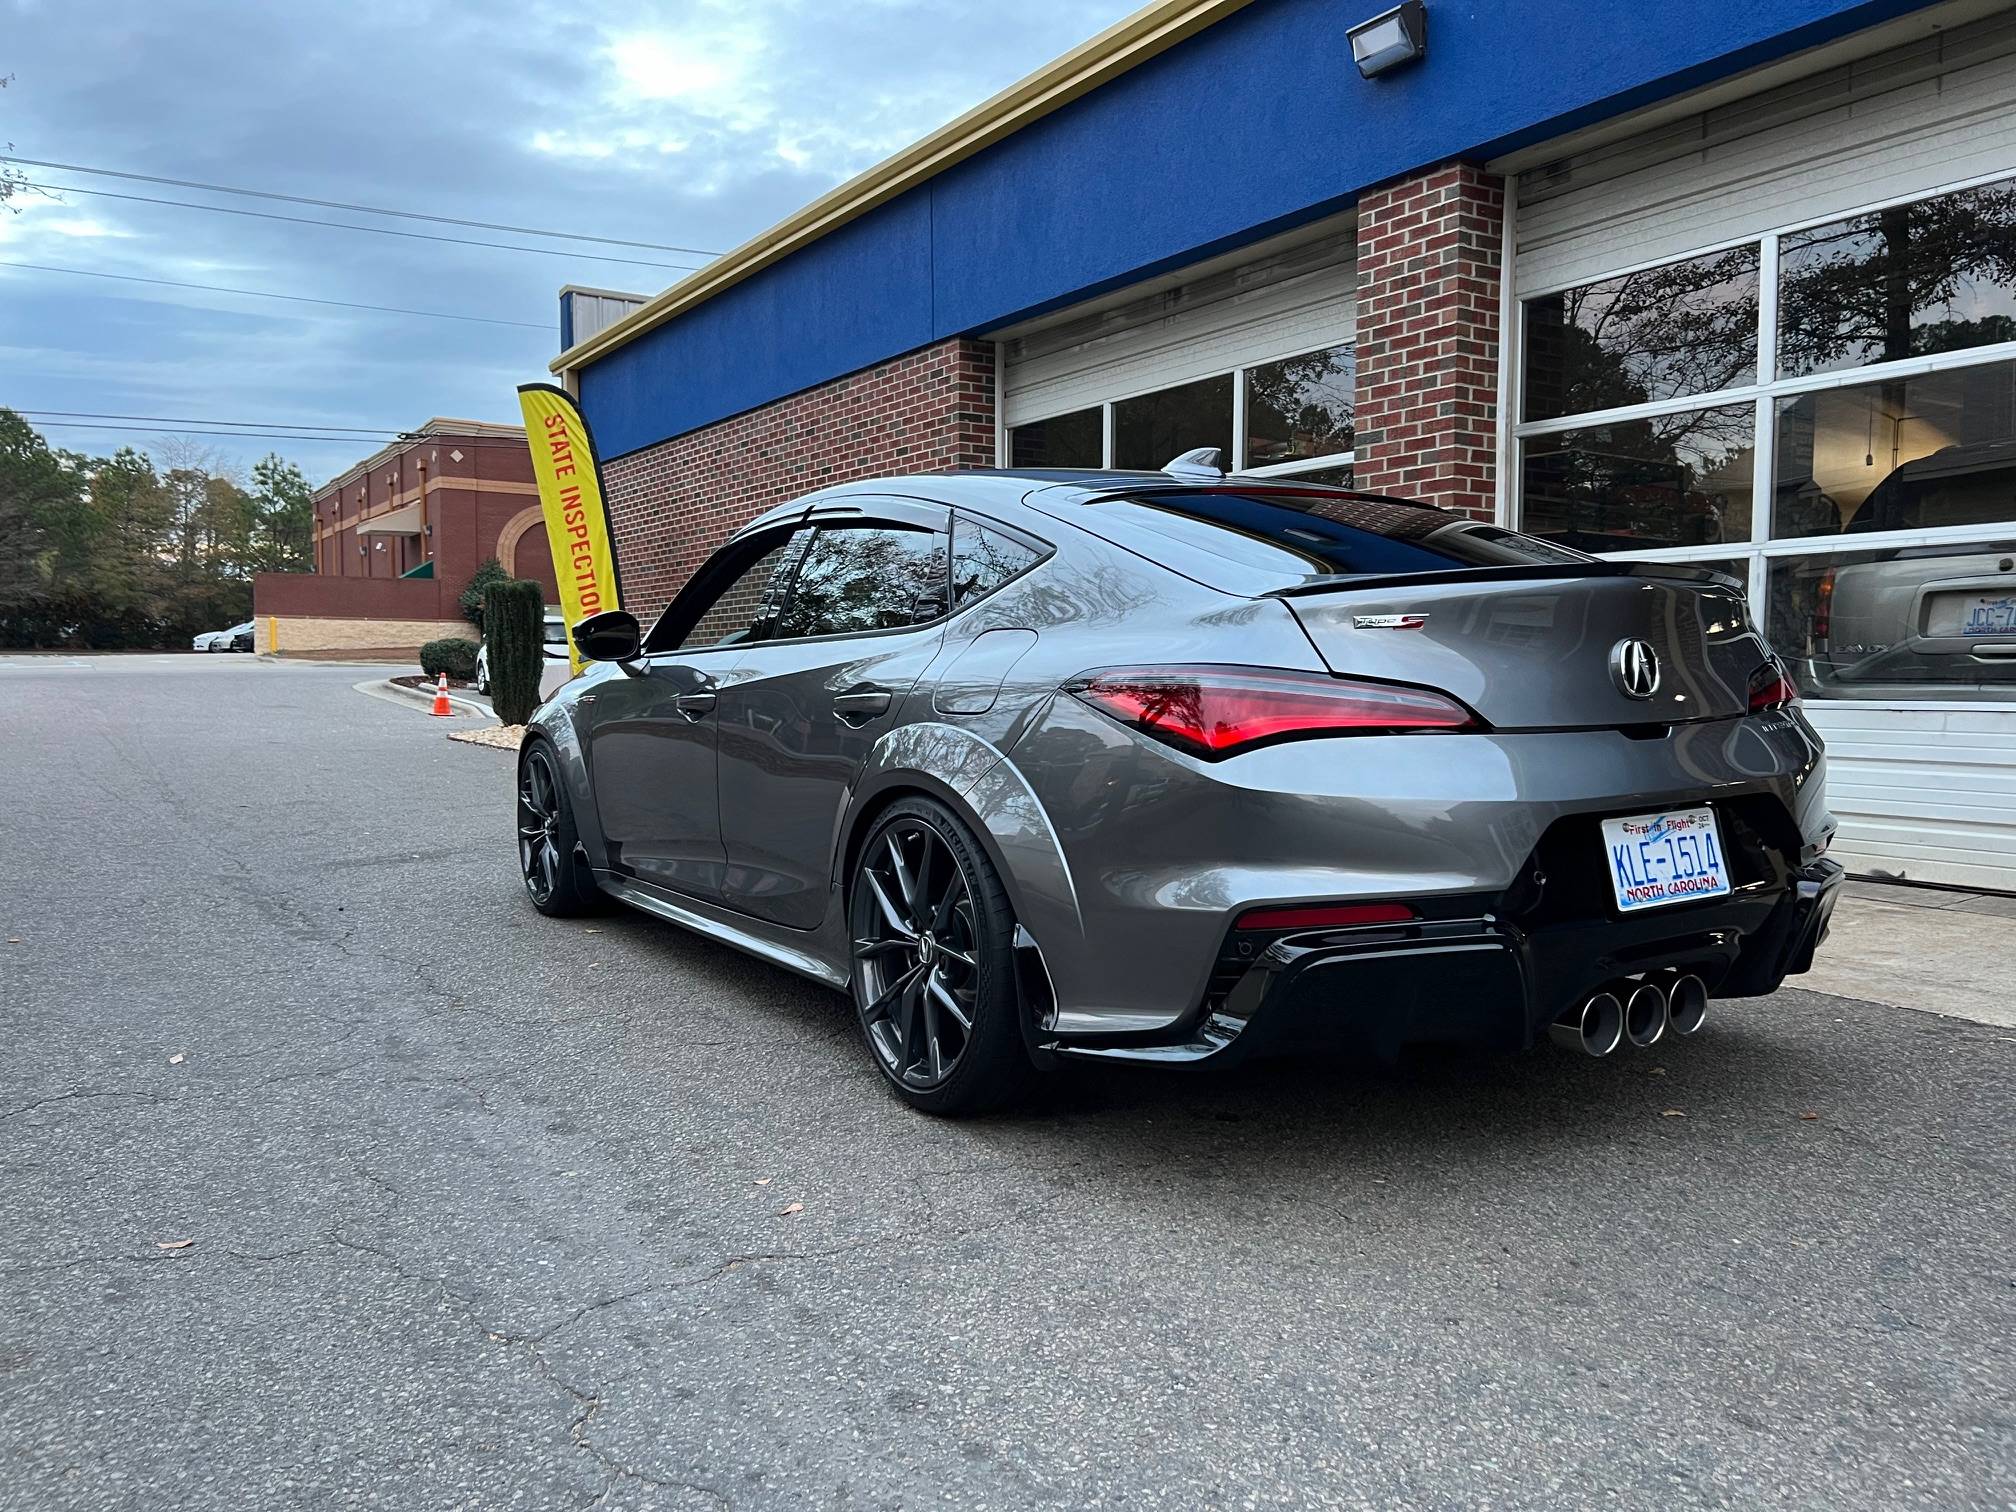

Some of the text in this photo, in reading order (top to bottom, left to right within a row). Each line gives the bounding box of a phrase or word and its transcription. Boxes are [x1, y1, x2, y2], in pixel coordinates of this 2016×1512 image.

[544, 412, 576, 480] STATE
[1359, 617, 1397, 627] Type
[1967, 607, 2016, 627] JCC-7
[1629, 819, 1691, 835] First in Flight
[1613, 833, 1719, 888] KLE-1514
[1627, 877, 1719, 903] NORTH CAROLINA
